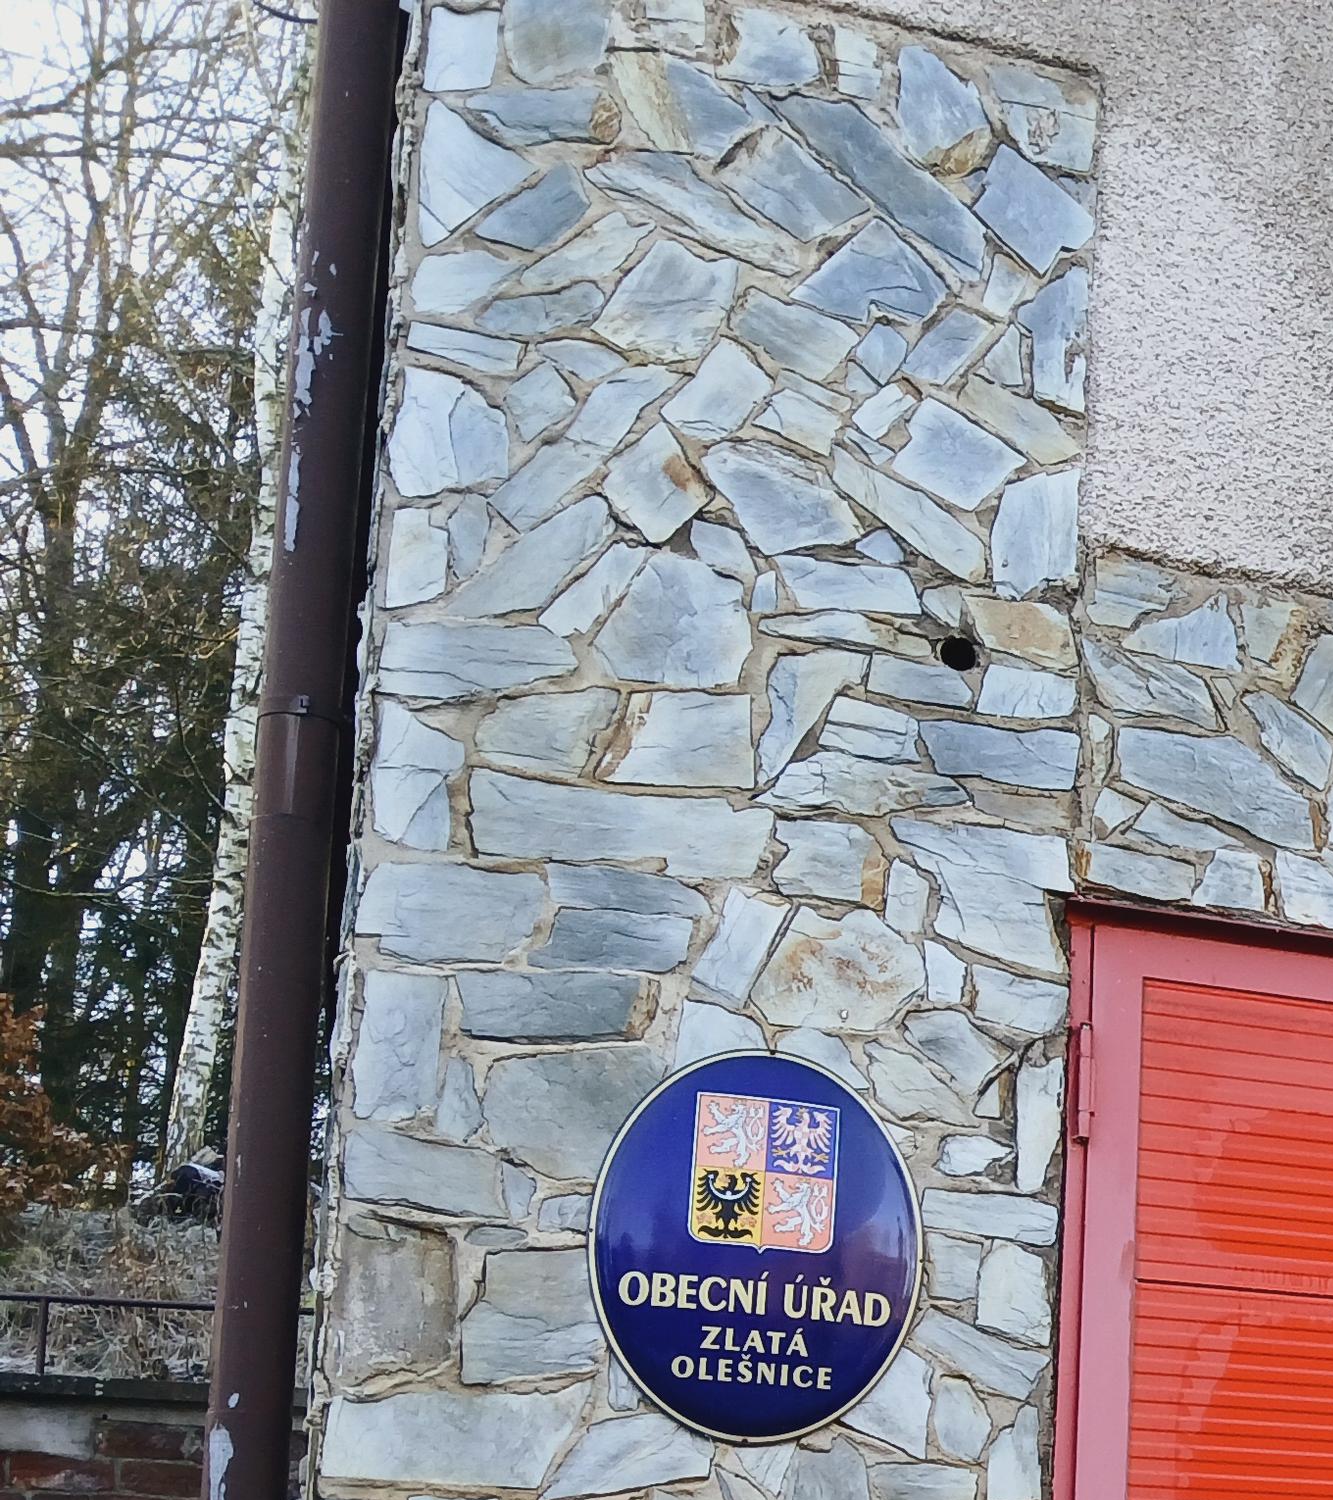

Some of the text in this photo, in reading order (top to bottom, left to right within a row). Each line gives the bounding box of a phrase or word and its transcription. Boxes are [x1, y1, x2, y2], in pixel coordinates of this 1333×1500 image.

[618, 1271, 891, 1327] OBECNÍ ÚŘAD
[700, 1325, 809, 1357] ZLATÁ
[671, 1354, 833, 1390] OLEŠNICE
